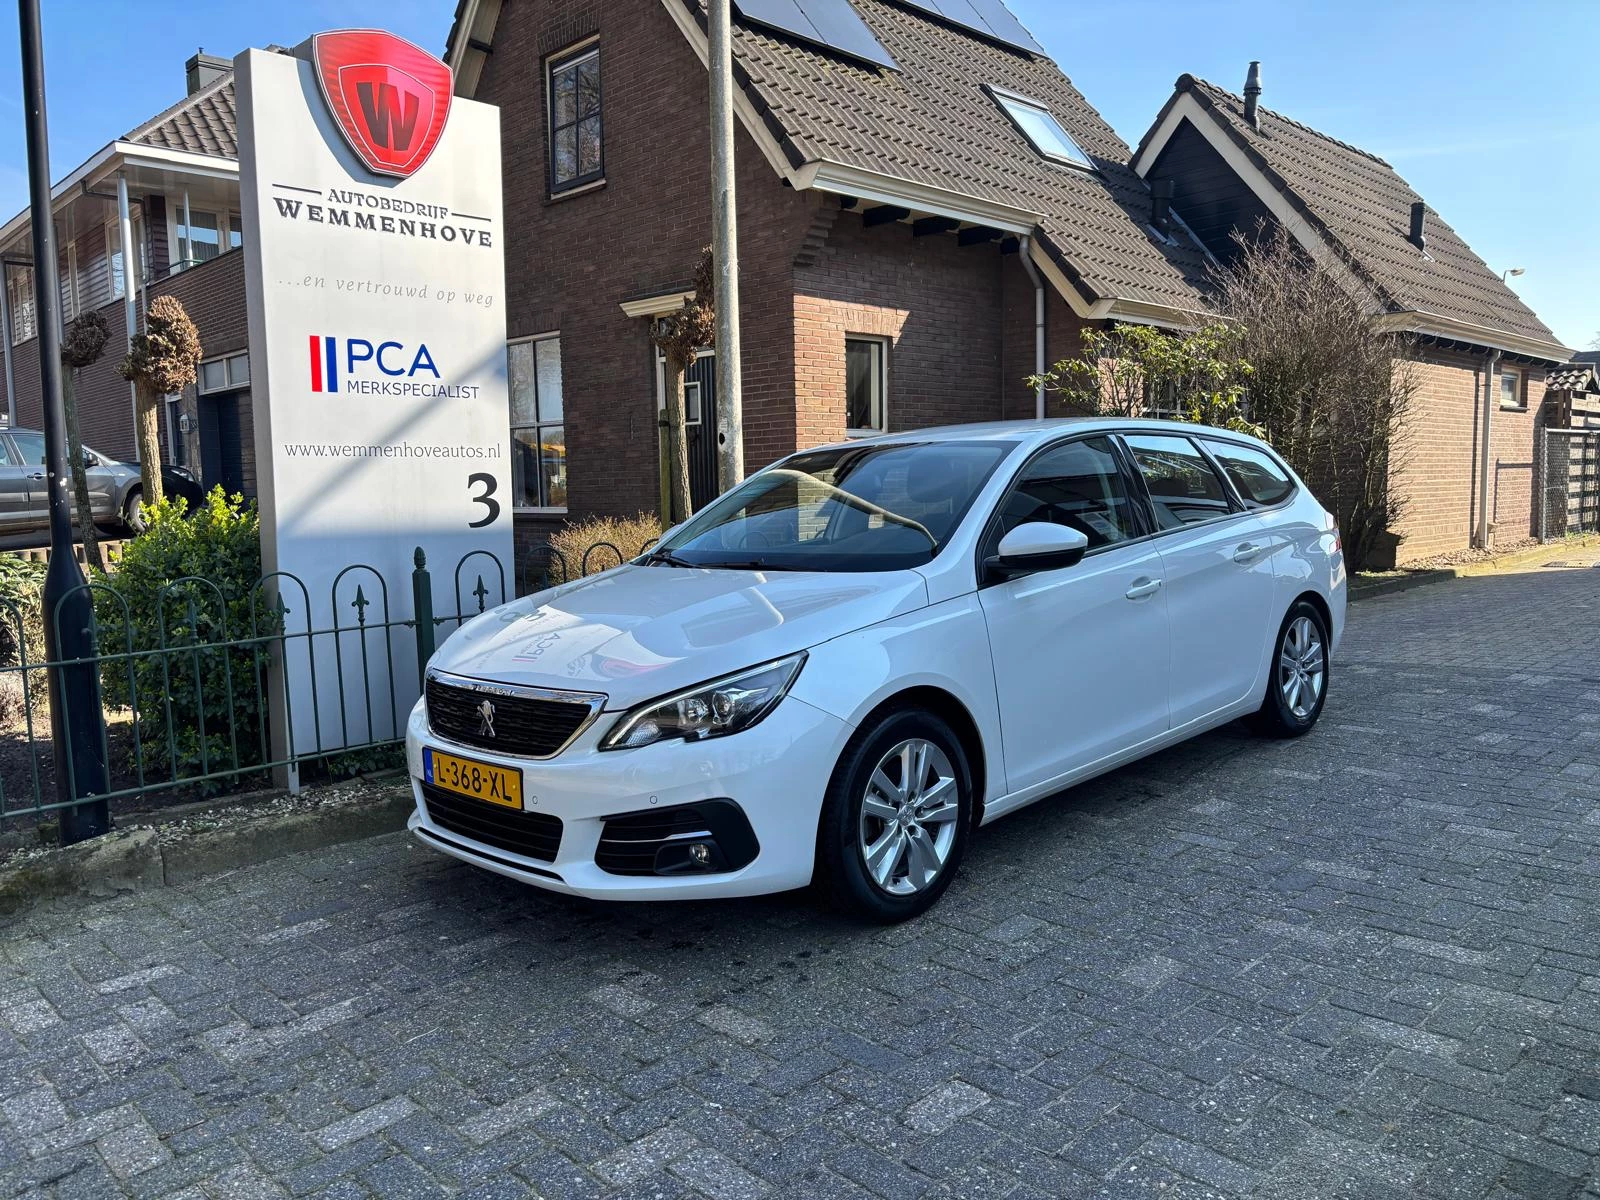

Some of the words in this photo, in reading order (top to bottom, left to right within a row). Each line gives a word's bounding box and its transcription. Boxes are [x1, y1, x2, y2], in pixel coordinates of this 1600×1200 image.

[327, 188, 449, 219] AUTOBEDRIJF
[273, 197, 492, 248] WEMMENHOVE
[336, 277, 428, 300] vertrouwd
[436, 290, 456, 304] op
[464, 293, 494, 308] weg
[346, 338, 441, 379] PCA
[347, 380, 480, 399] MERKSPECIALIST
[285, 442, 501, 459] www.wemmenhoveautos.nl
[467, 472, 501, 529] 3
[437, 757, 513, 802] L-368-XL
